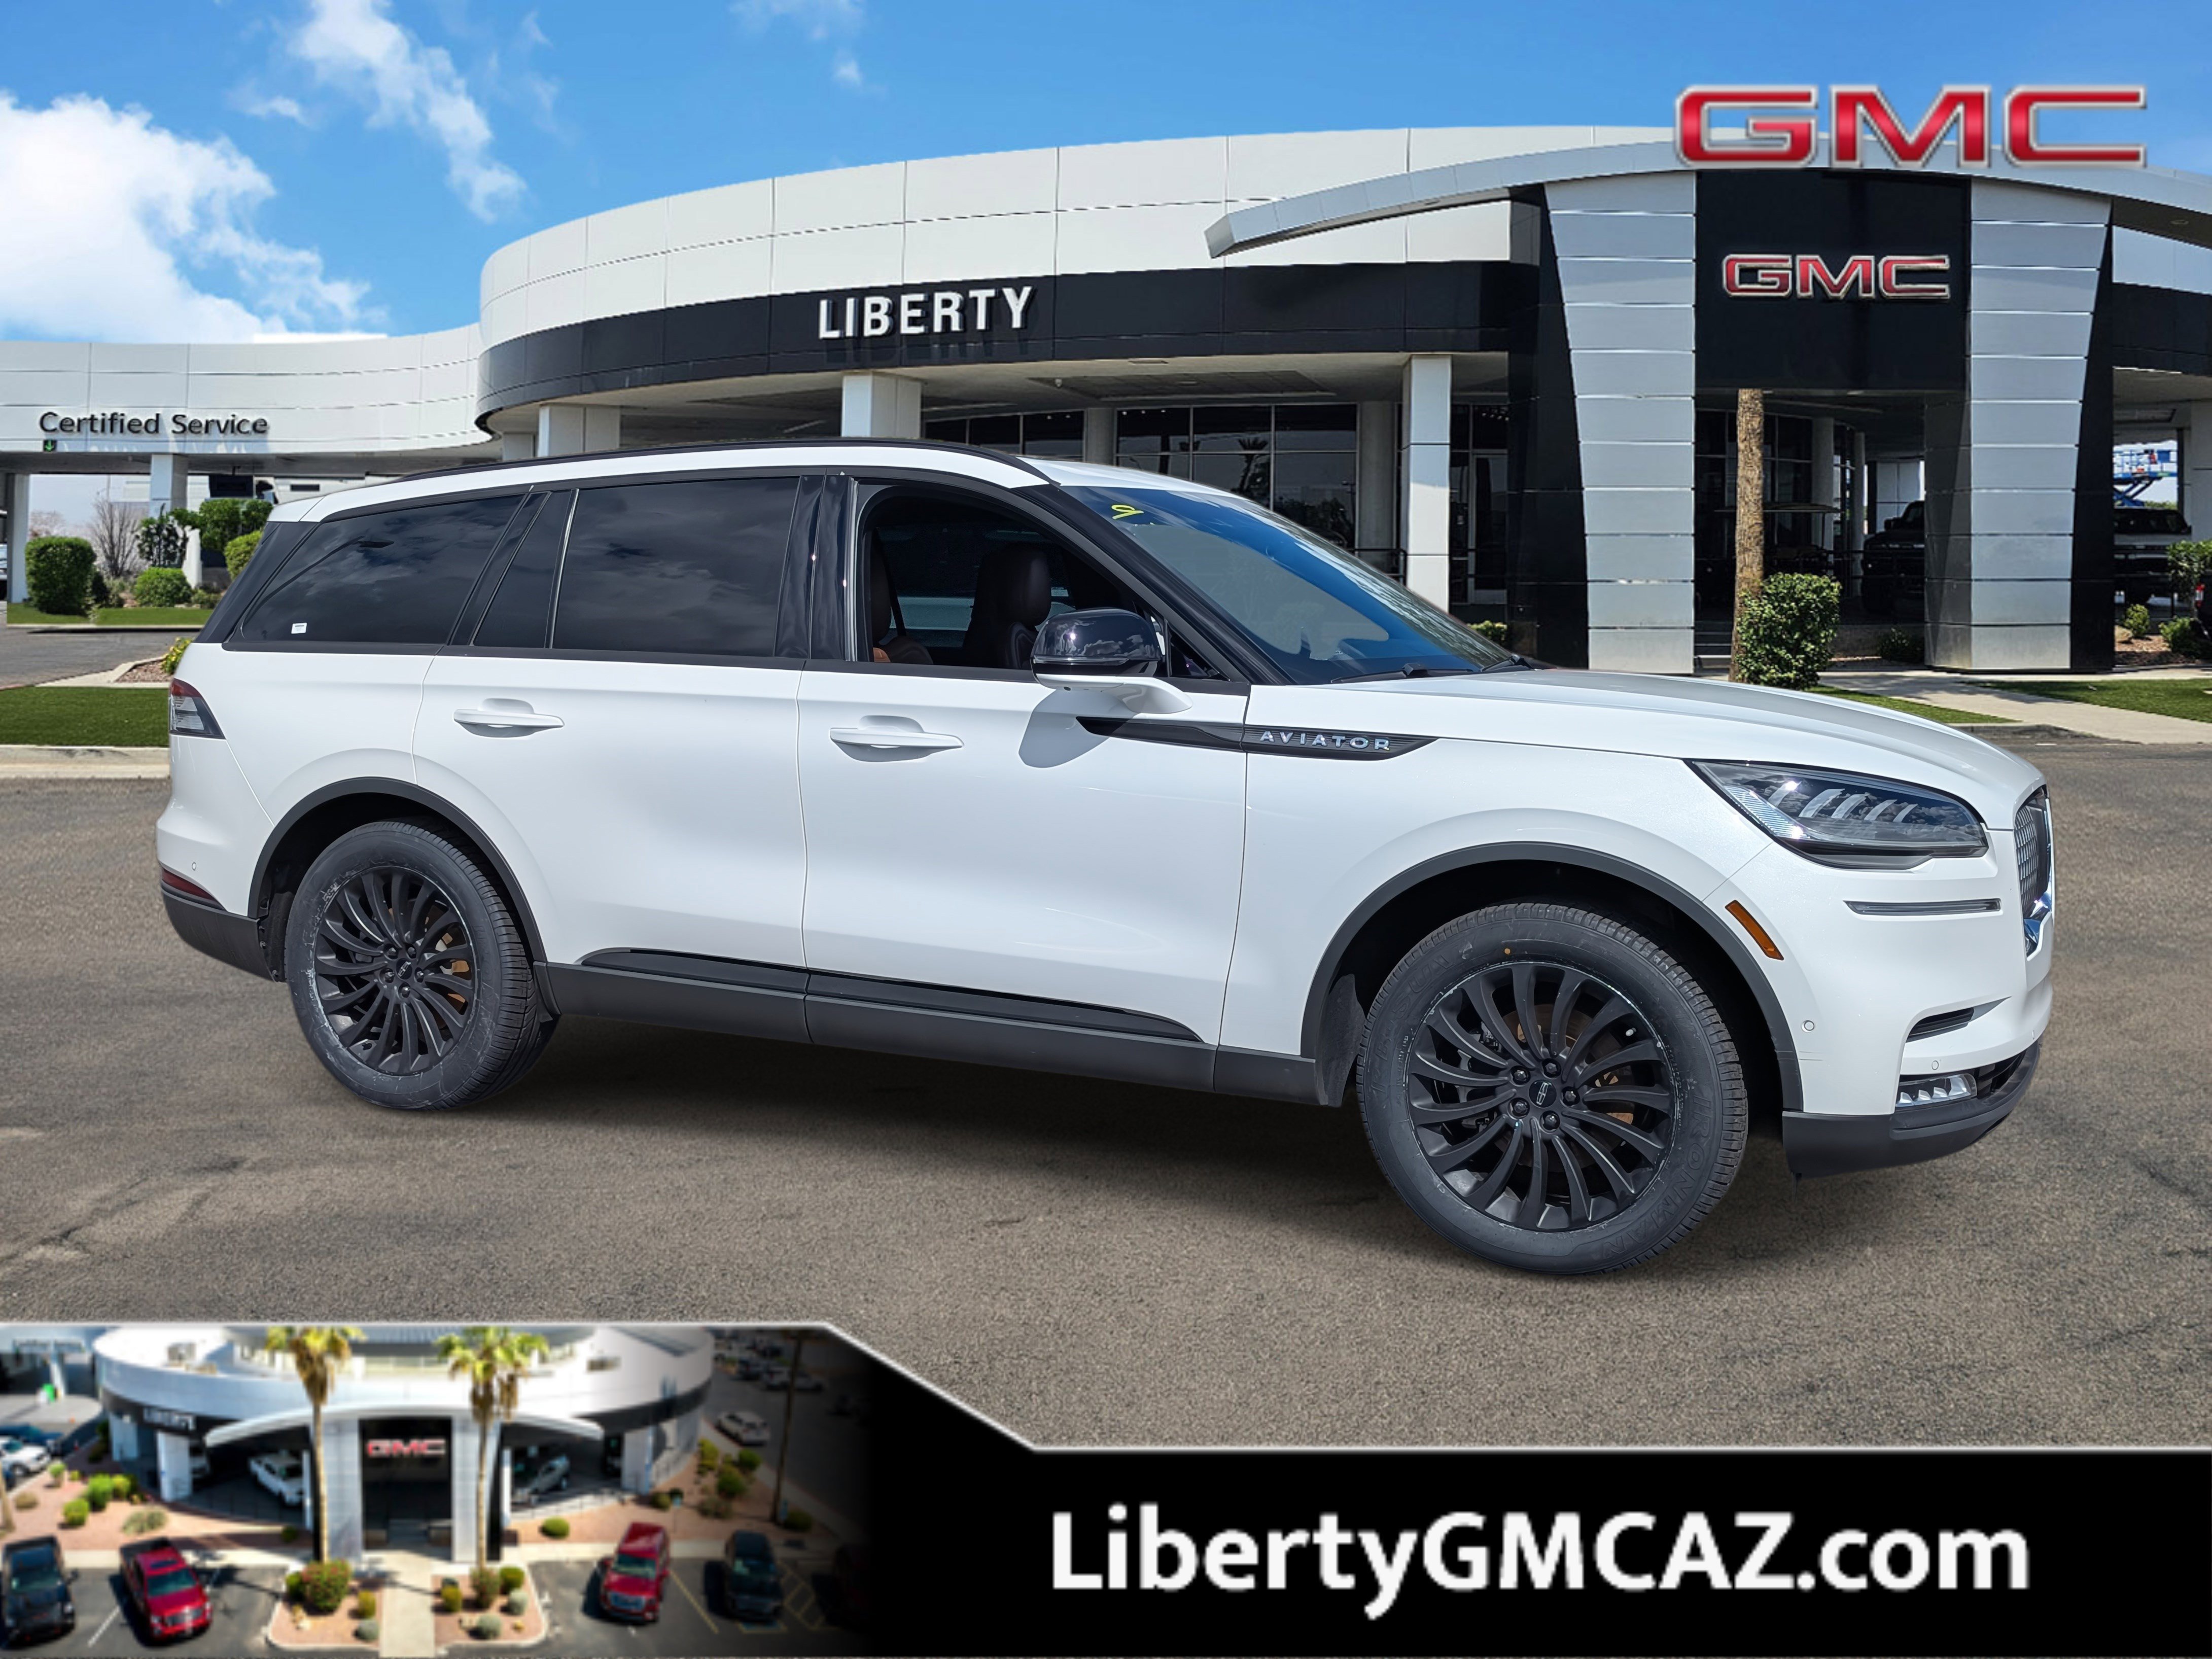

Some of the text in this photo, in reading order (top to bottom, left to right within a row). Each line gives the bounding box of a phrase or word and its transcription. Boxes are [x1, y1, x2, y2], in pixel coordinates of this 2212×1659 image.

[1723, 254, 1950, 299] GMC
[818, 286, 1032, 340] LIBERTY
[39, 411, 268, 434] Certified Service
[1259, 731, 1390, 751] AVIATOR
[1601, 1095, 1712, 1260] IRONMAN
